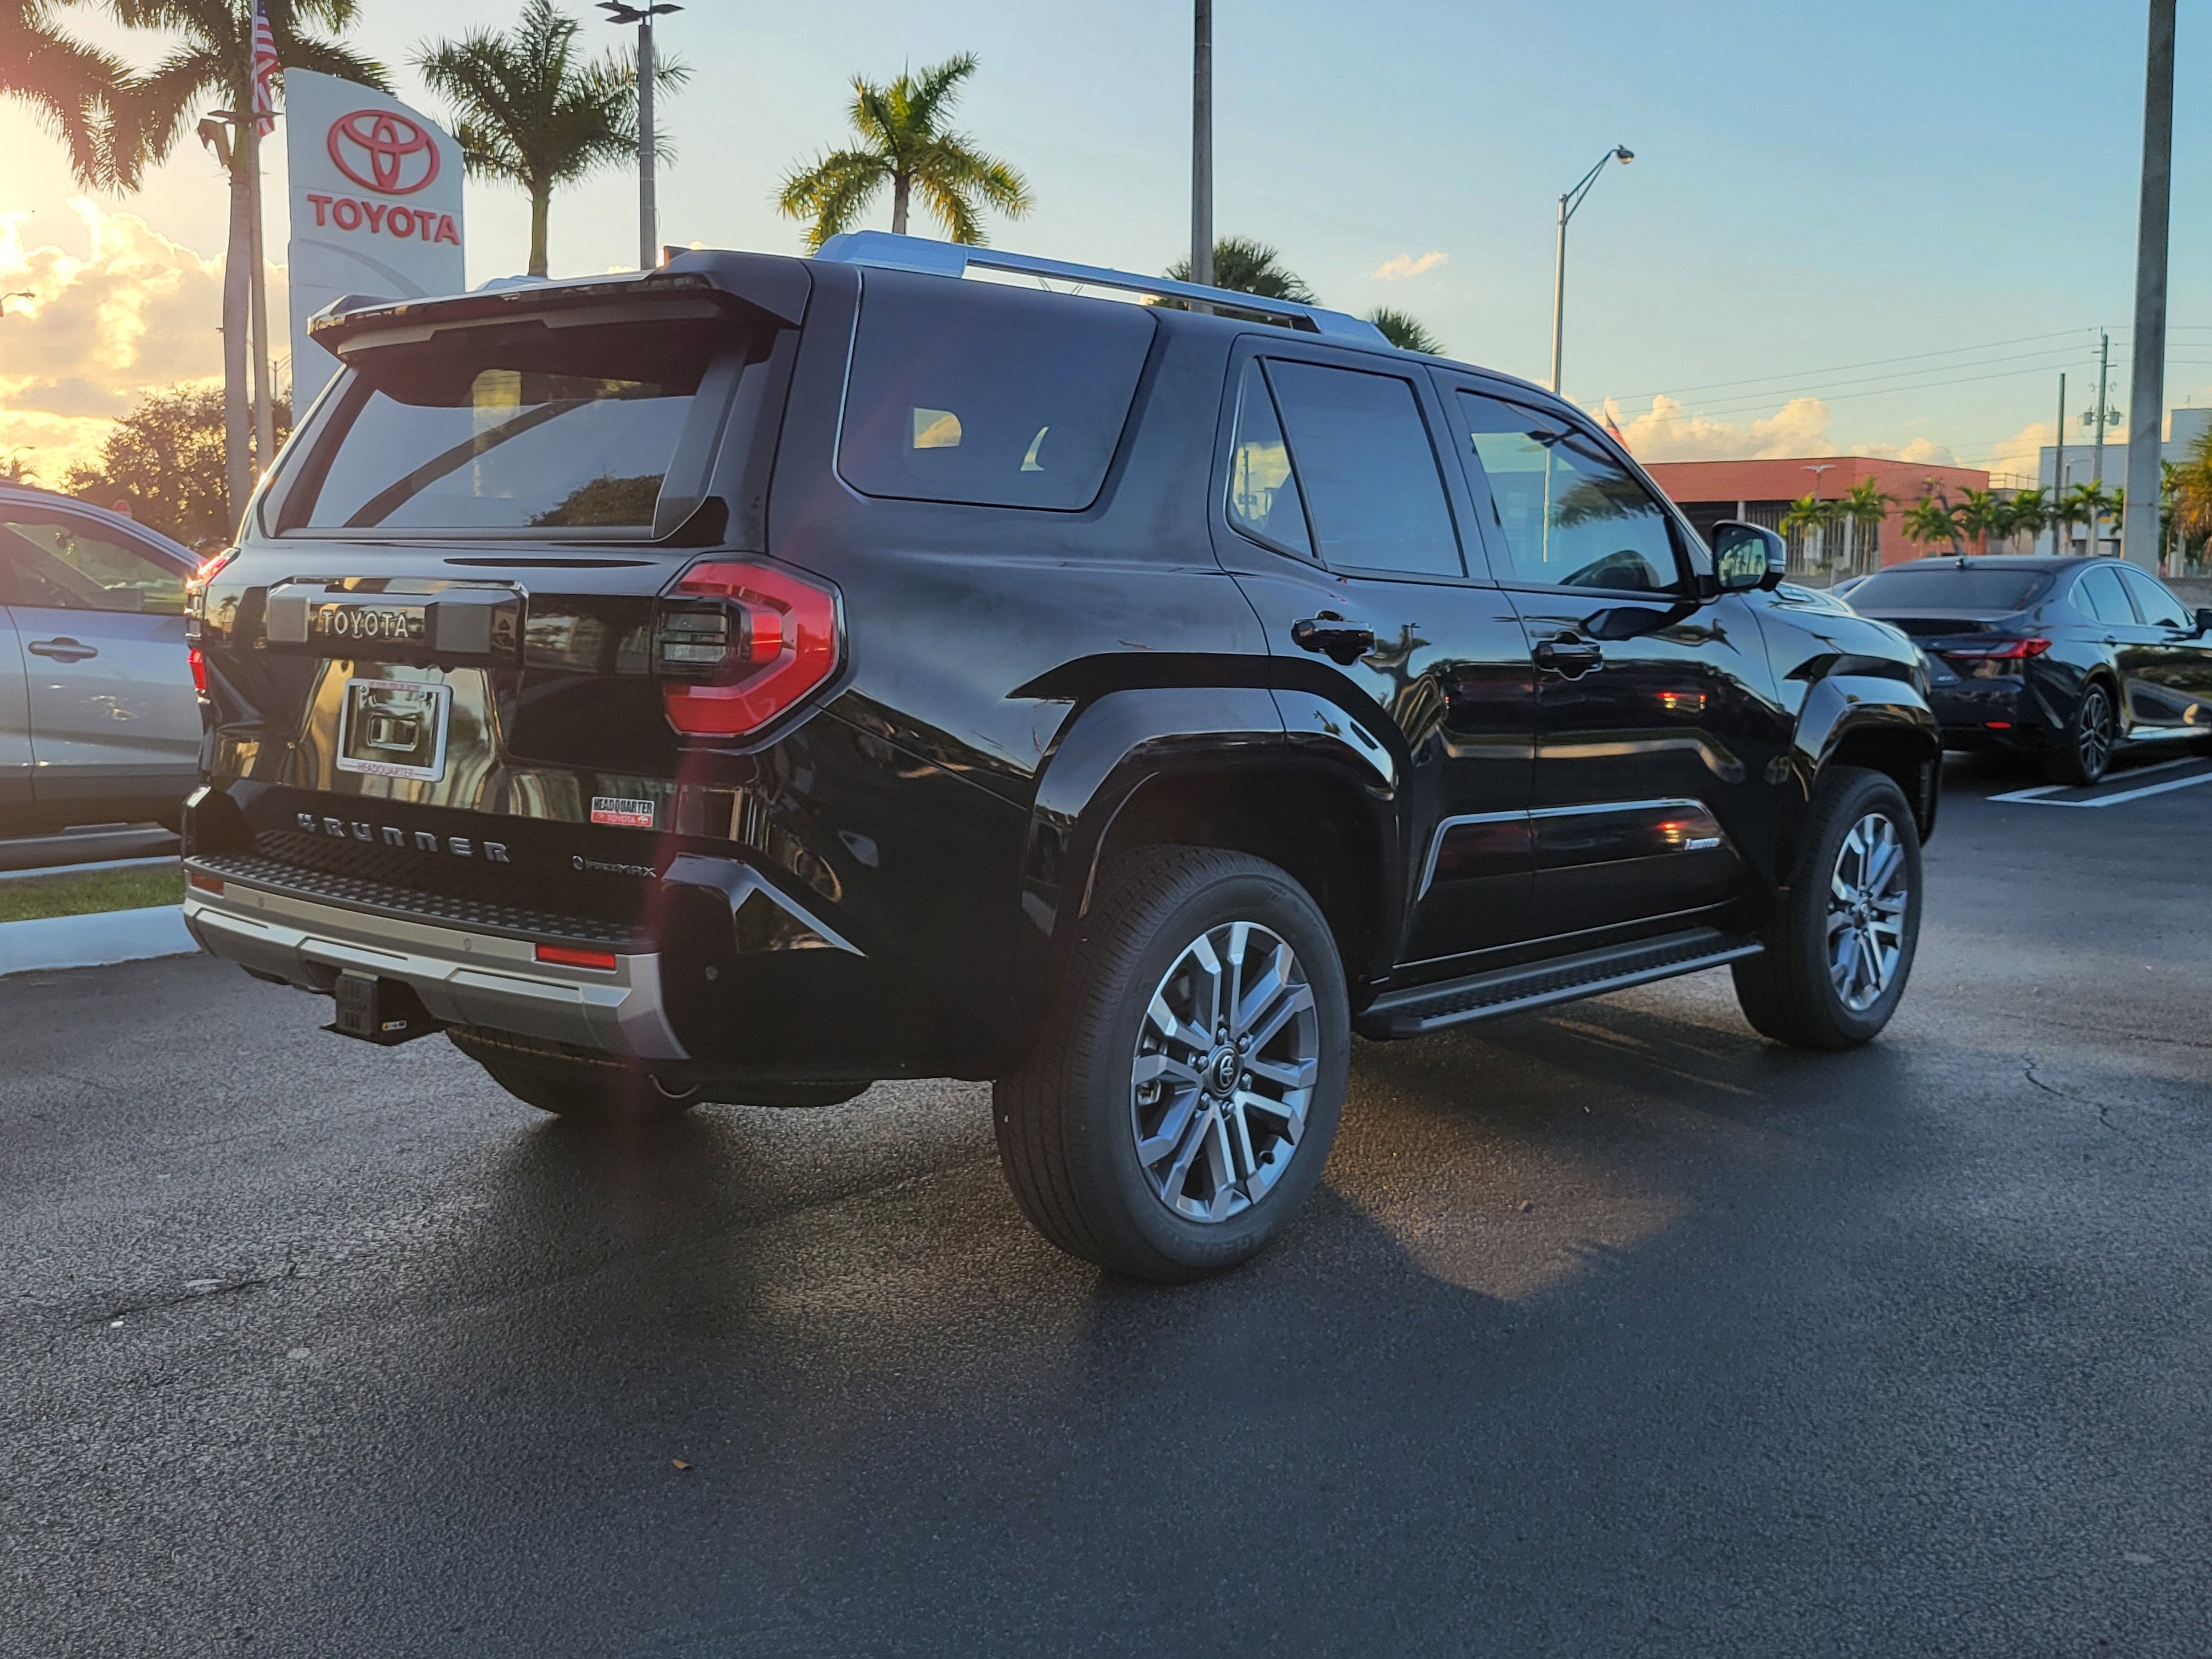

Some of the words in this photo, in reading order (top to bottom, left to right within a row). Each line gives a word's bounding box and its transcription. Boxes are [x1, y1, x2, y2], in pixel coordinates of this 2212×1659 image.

[307, 194, 460, 246] TOYOTA
[323, 610, 409, 637] TOYOTA
[594, 798, 652, 814] HEADQUARTER
[607, 814, 636, 823] TOYOTA
[297, 812, 511, 862] 4RUNNER
